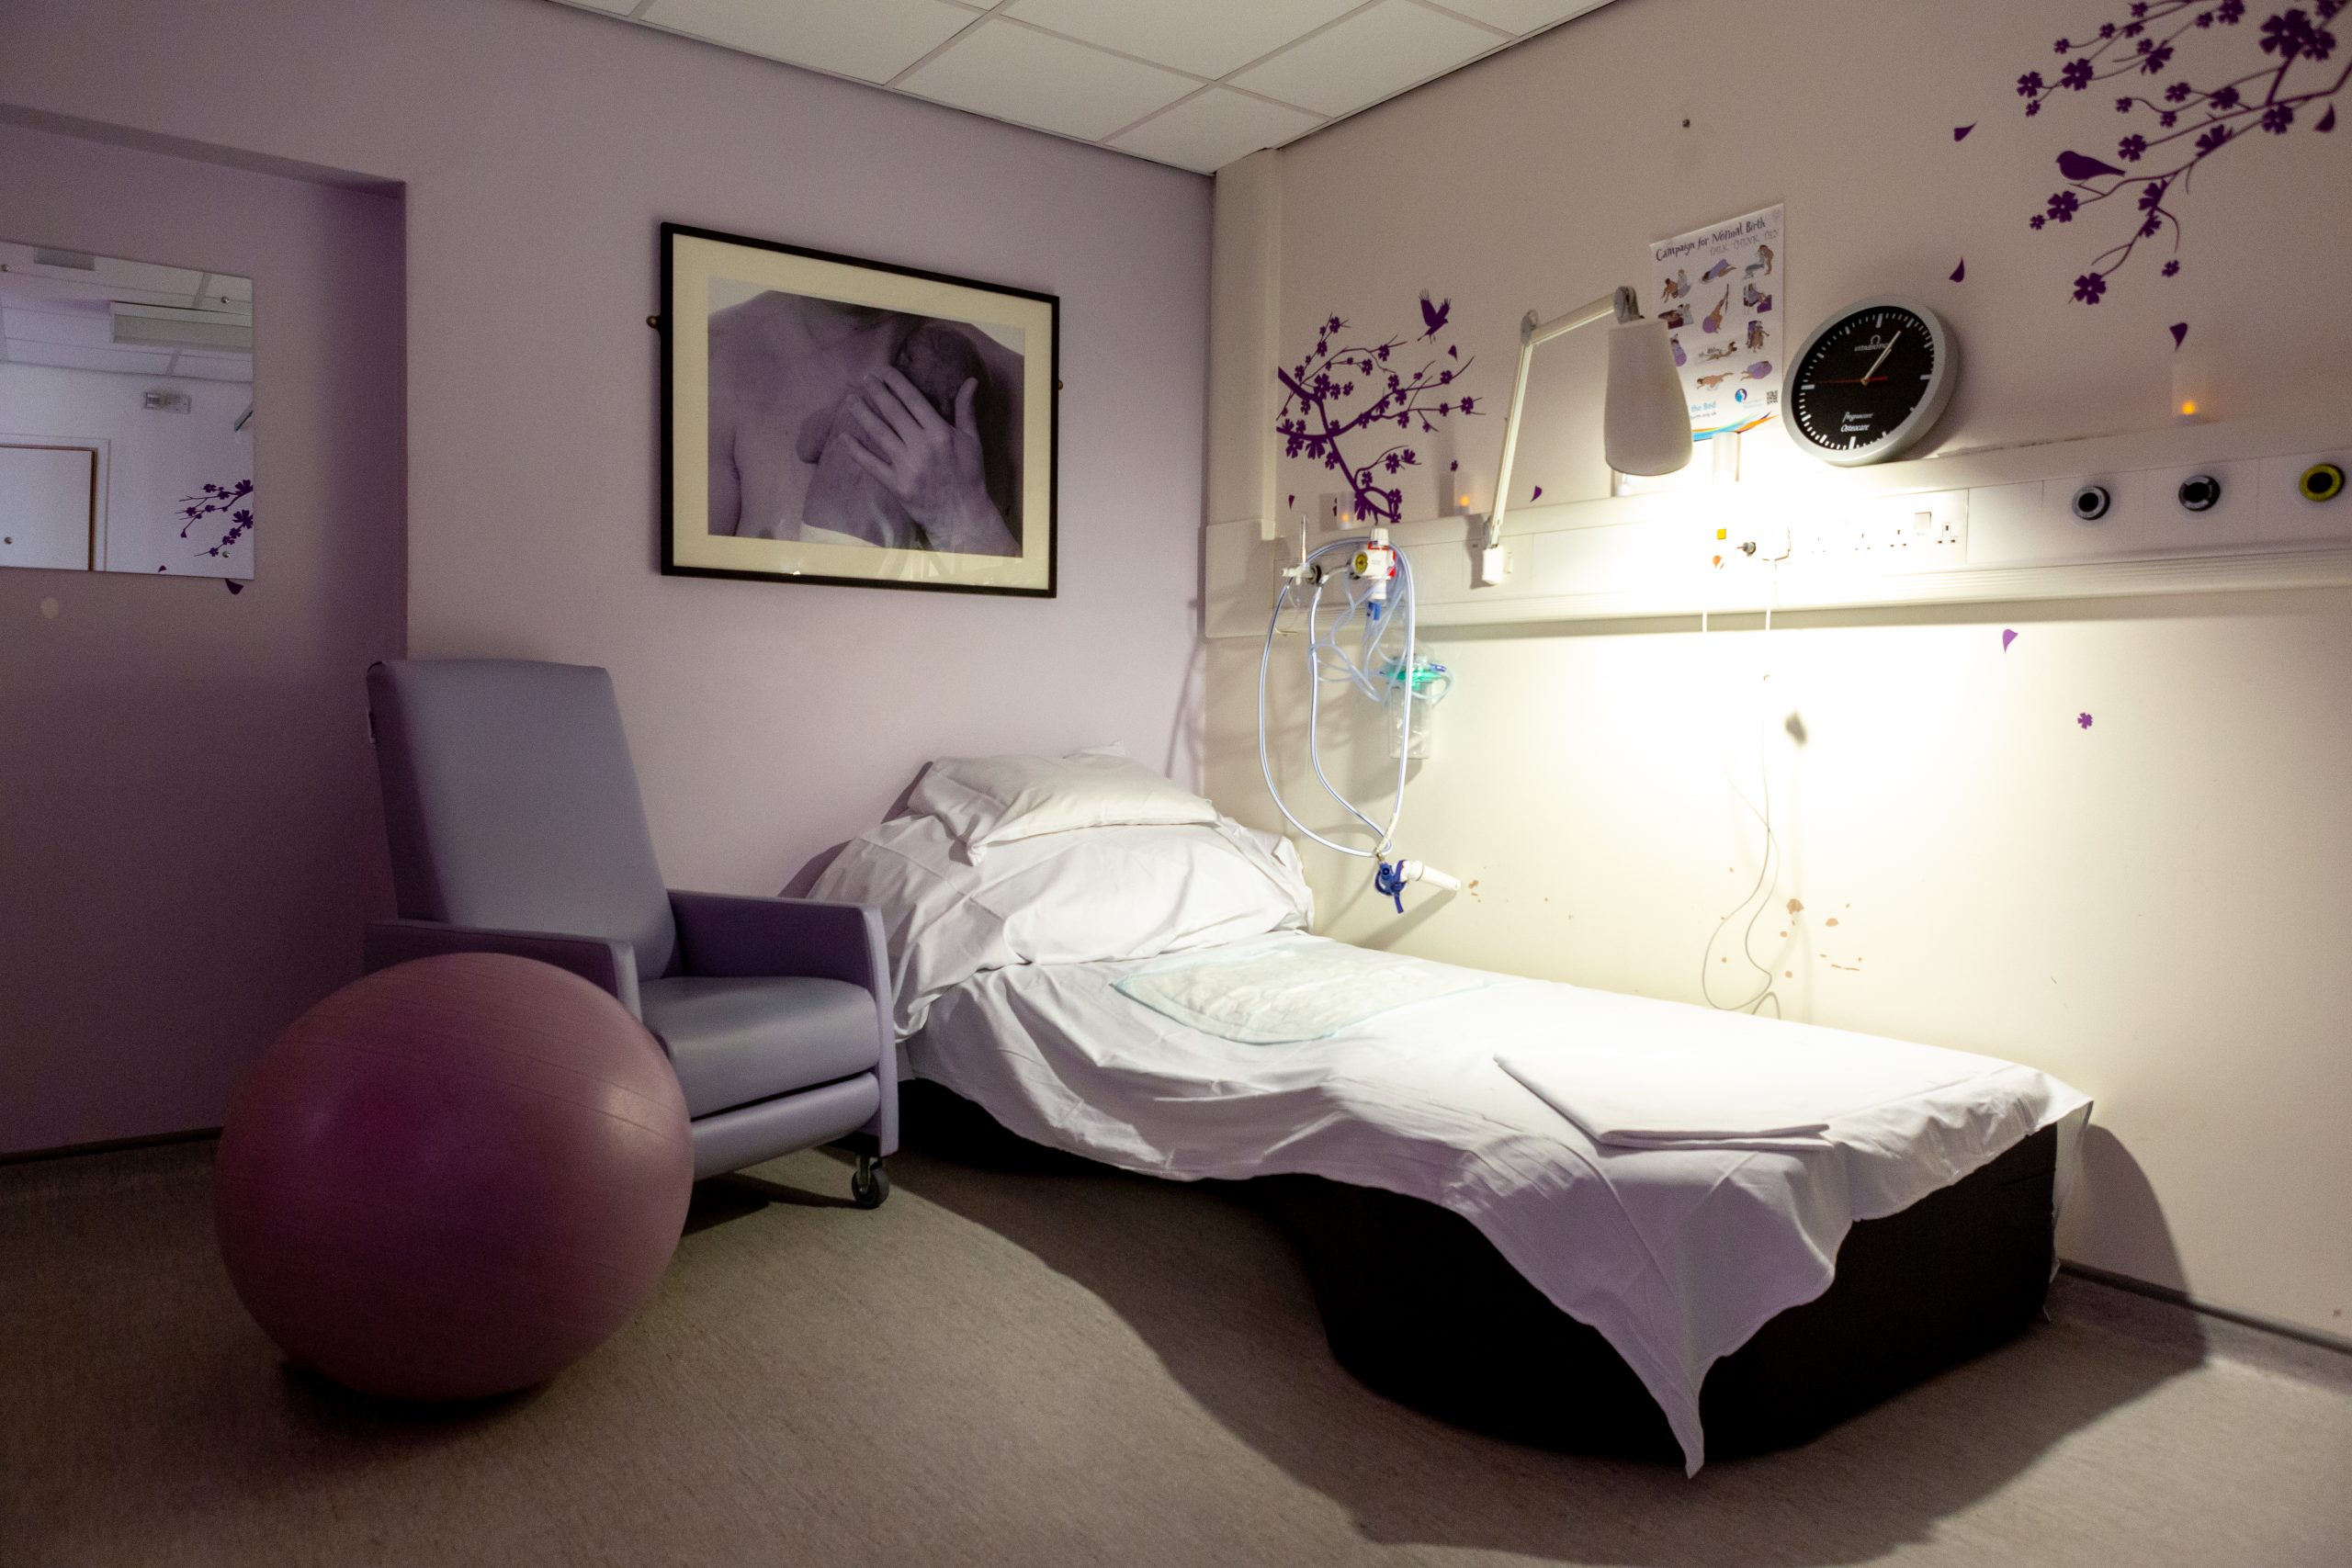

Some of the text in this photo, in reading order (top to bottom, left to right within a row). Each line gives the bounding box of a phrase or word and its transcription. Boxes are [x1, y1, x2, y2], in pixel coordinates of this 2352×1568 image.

[1656, 217, 1766, 262] Campaign for Normal Birth
